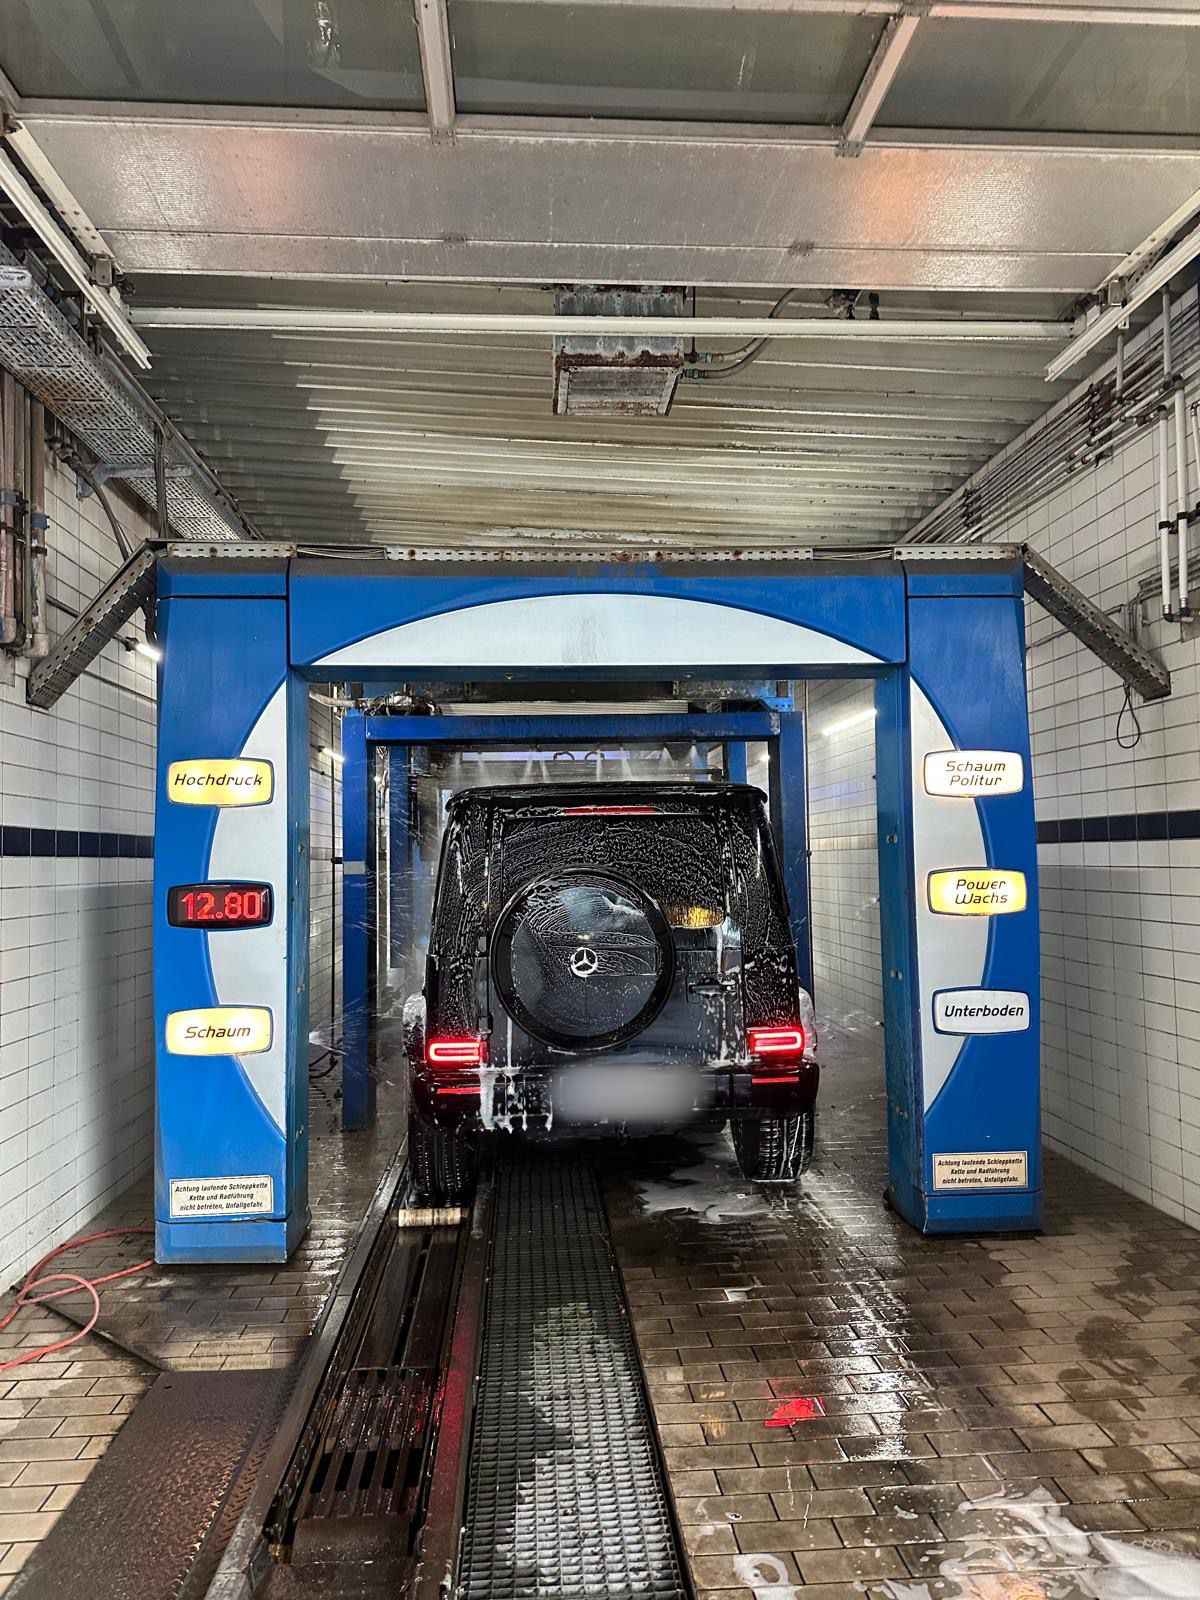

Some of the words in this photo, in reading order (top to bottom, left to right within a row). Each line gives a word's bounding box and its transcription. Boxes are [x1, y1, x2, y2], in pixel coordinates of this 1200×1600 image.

[945, 760, 1006, 772] Schaum
[174, 773, 263, 786] Hochdruck
[949, 774, 1002, 786] Politur
[956, 879, 1006, 890] Power
[955, 892, 1008, 904] Wachs
[181, 891, 261, 920] 12.80
[944, 1004, 1024, 1017] Unterboden
[184, 1025, 251, 1038] Schaum
